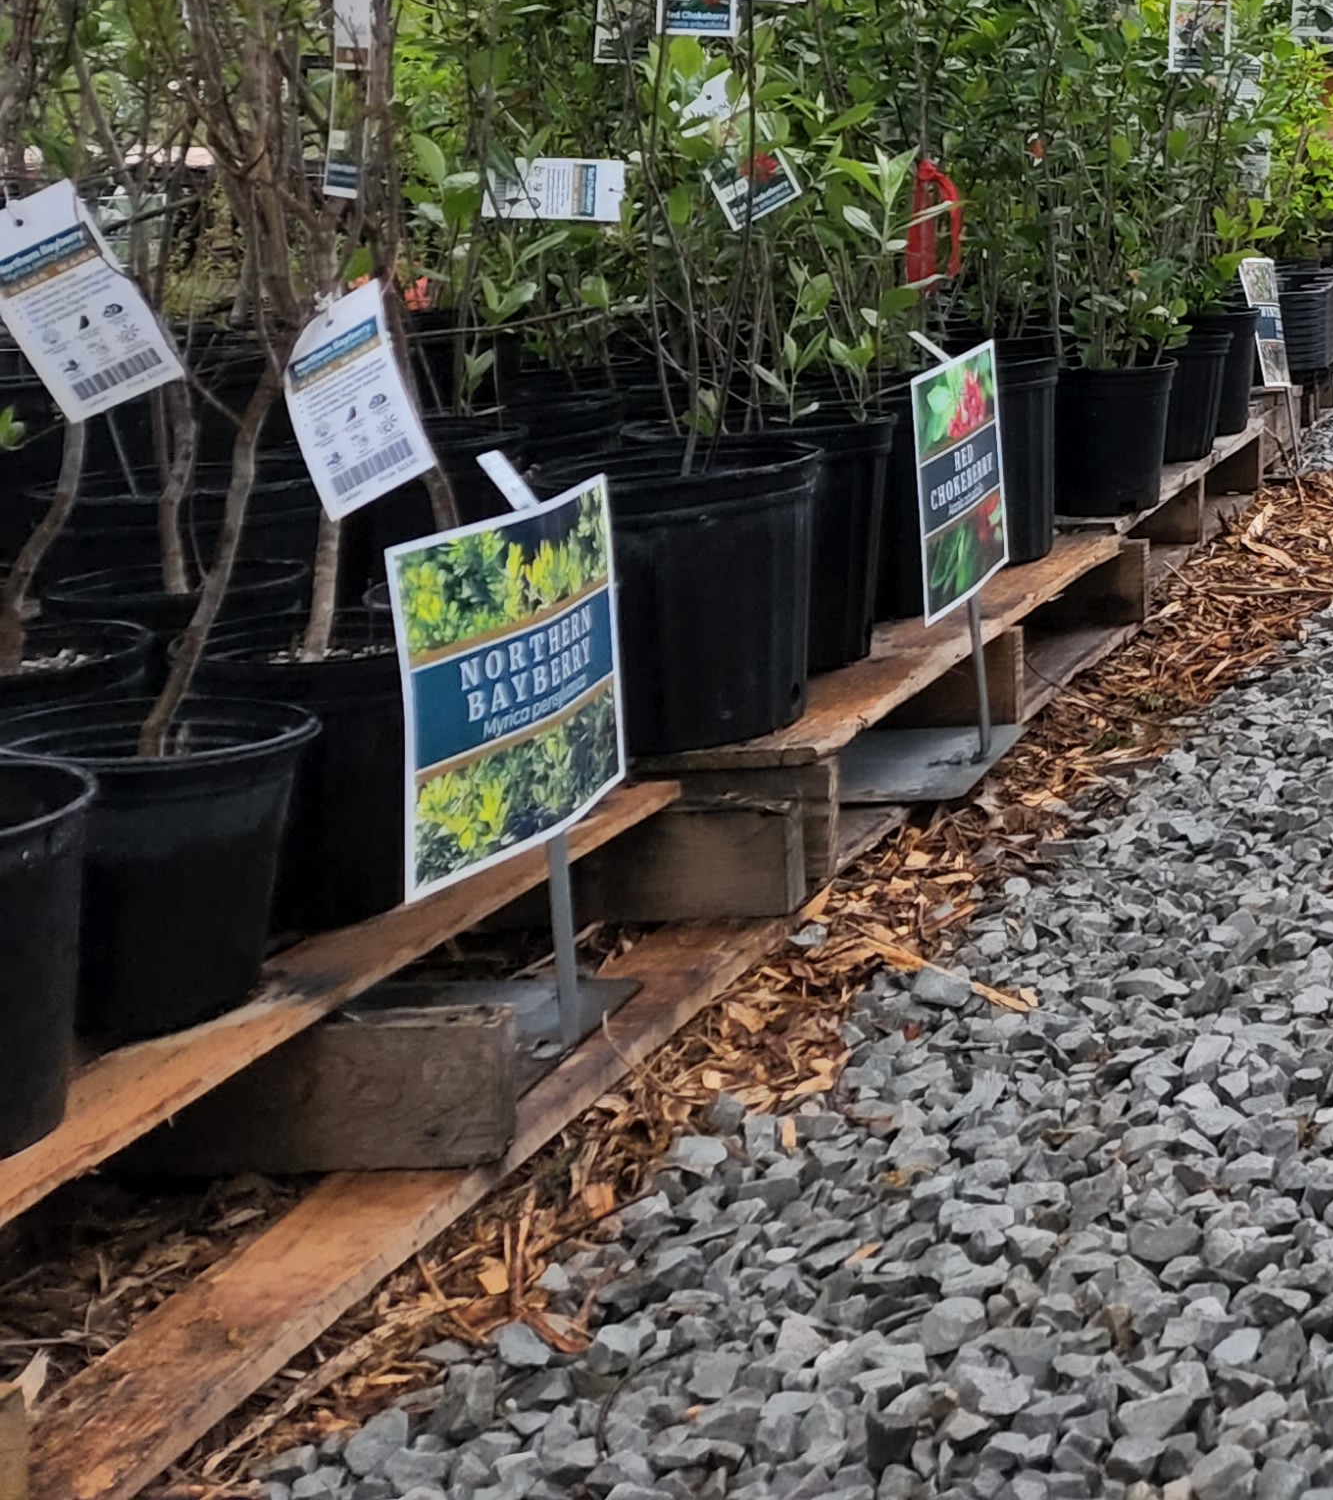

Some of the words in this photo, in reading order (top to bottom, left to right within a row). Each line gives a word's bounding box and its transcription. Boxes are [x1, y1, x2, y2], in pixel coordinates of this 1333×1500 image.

[682, 11, 729, 23] Chokeberry
[930, 452, 994, 512] CHOKEBERRY
[954, 443, 975, 473] RED
[459, 604, 594, 693] NORTHERN
[467, 636, 593, 724] BAYBERRY
[483, 702, 531, 741] Myrica
